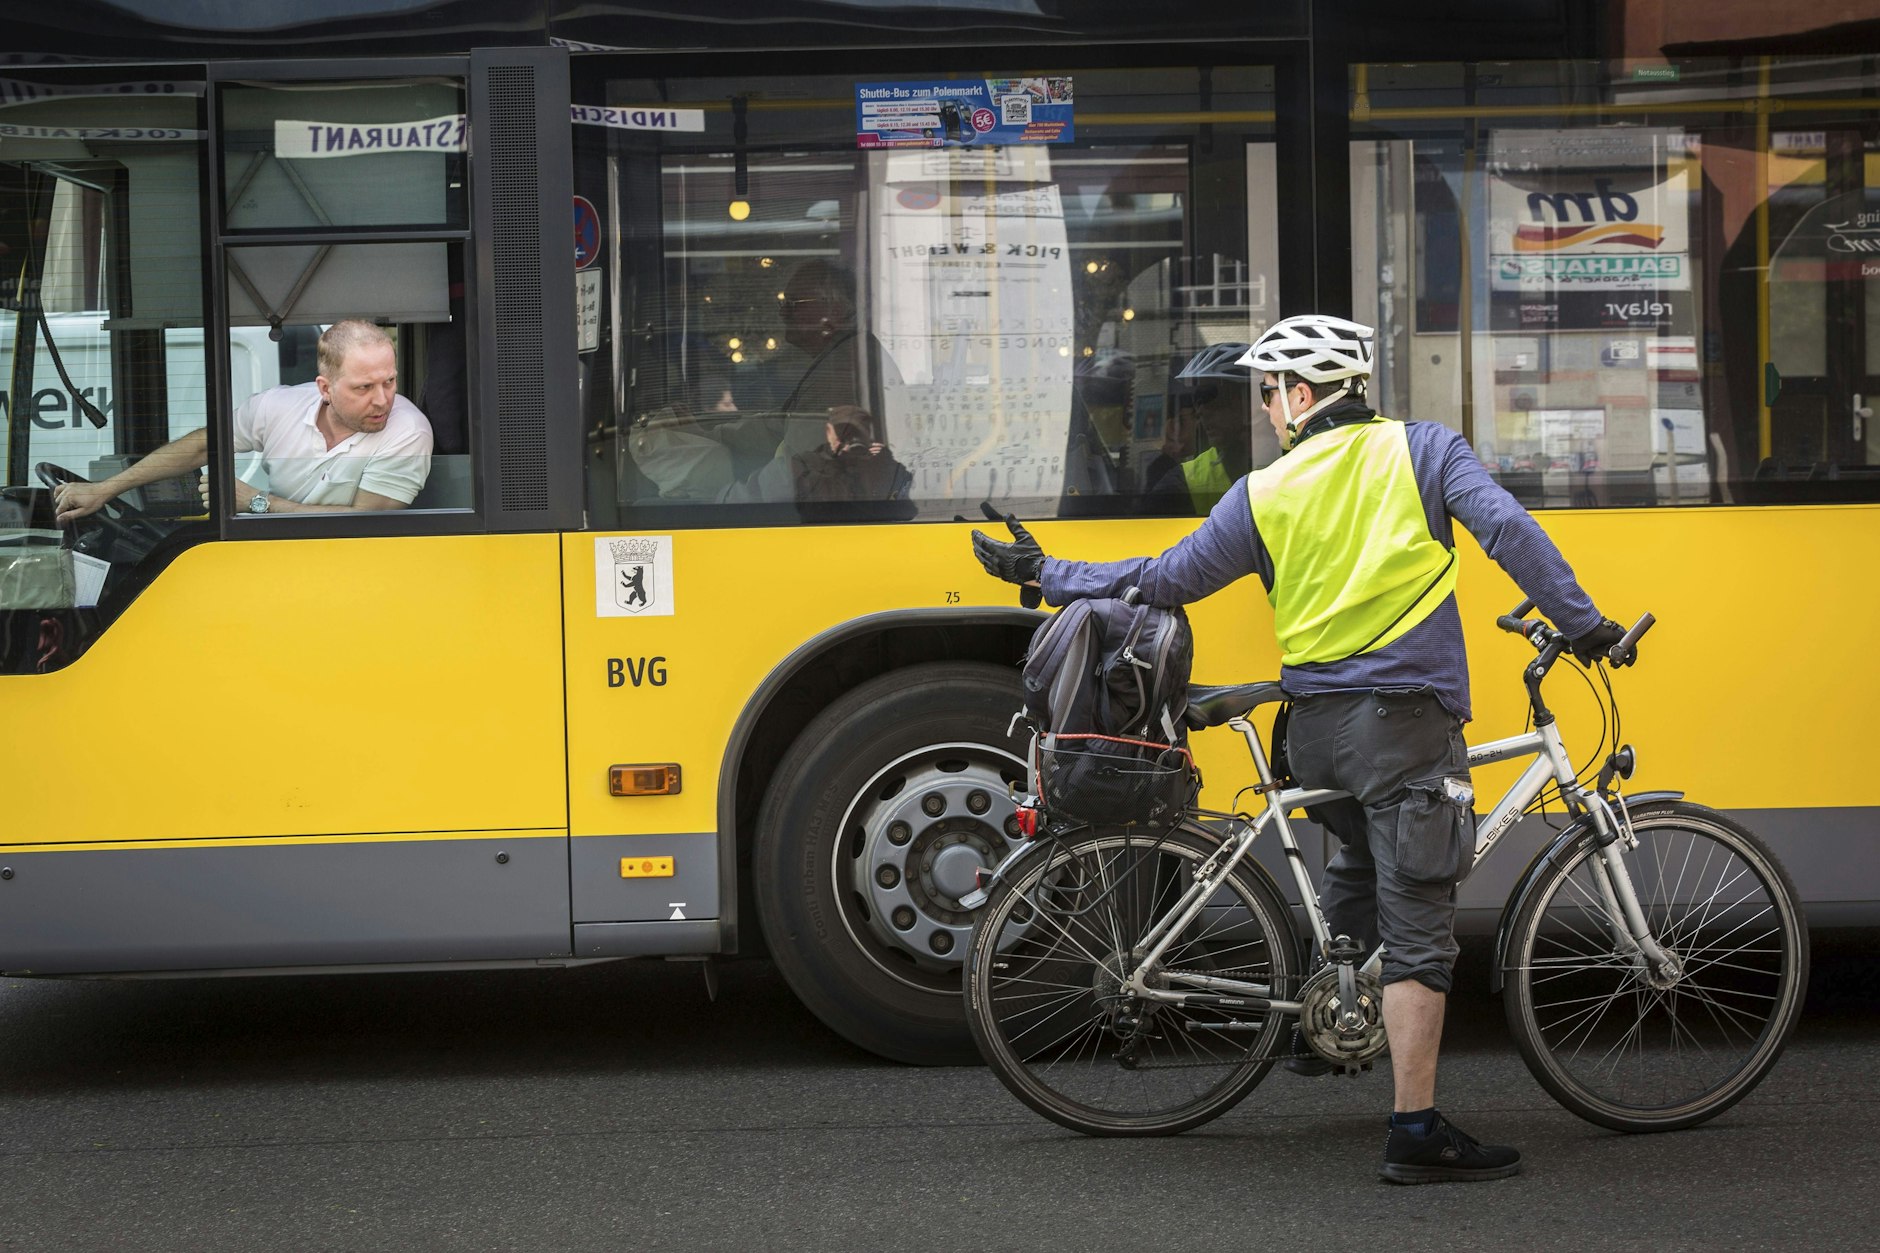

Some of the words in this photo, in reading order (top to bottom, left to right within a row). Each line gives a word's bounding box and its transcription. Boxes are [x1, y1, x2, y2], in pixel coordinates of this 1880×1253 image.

[860, 88, 910, 99] Shuttle-Bus
[912, 87, 931, 97] zum
[933, 85, 983, 97] Polenmarkt
[945, 591, 960, 604] 7,5
[607, 656, 667, 688] BVG
[1486, 806, 1519, 842] BIKES
[804, 851, 816, 895] Urban
